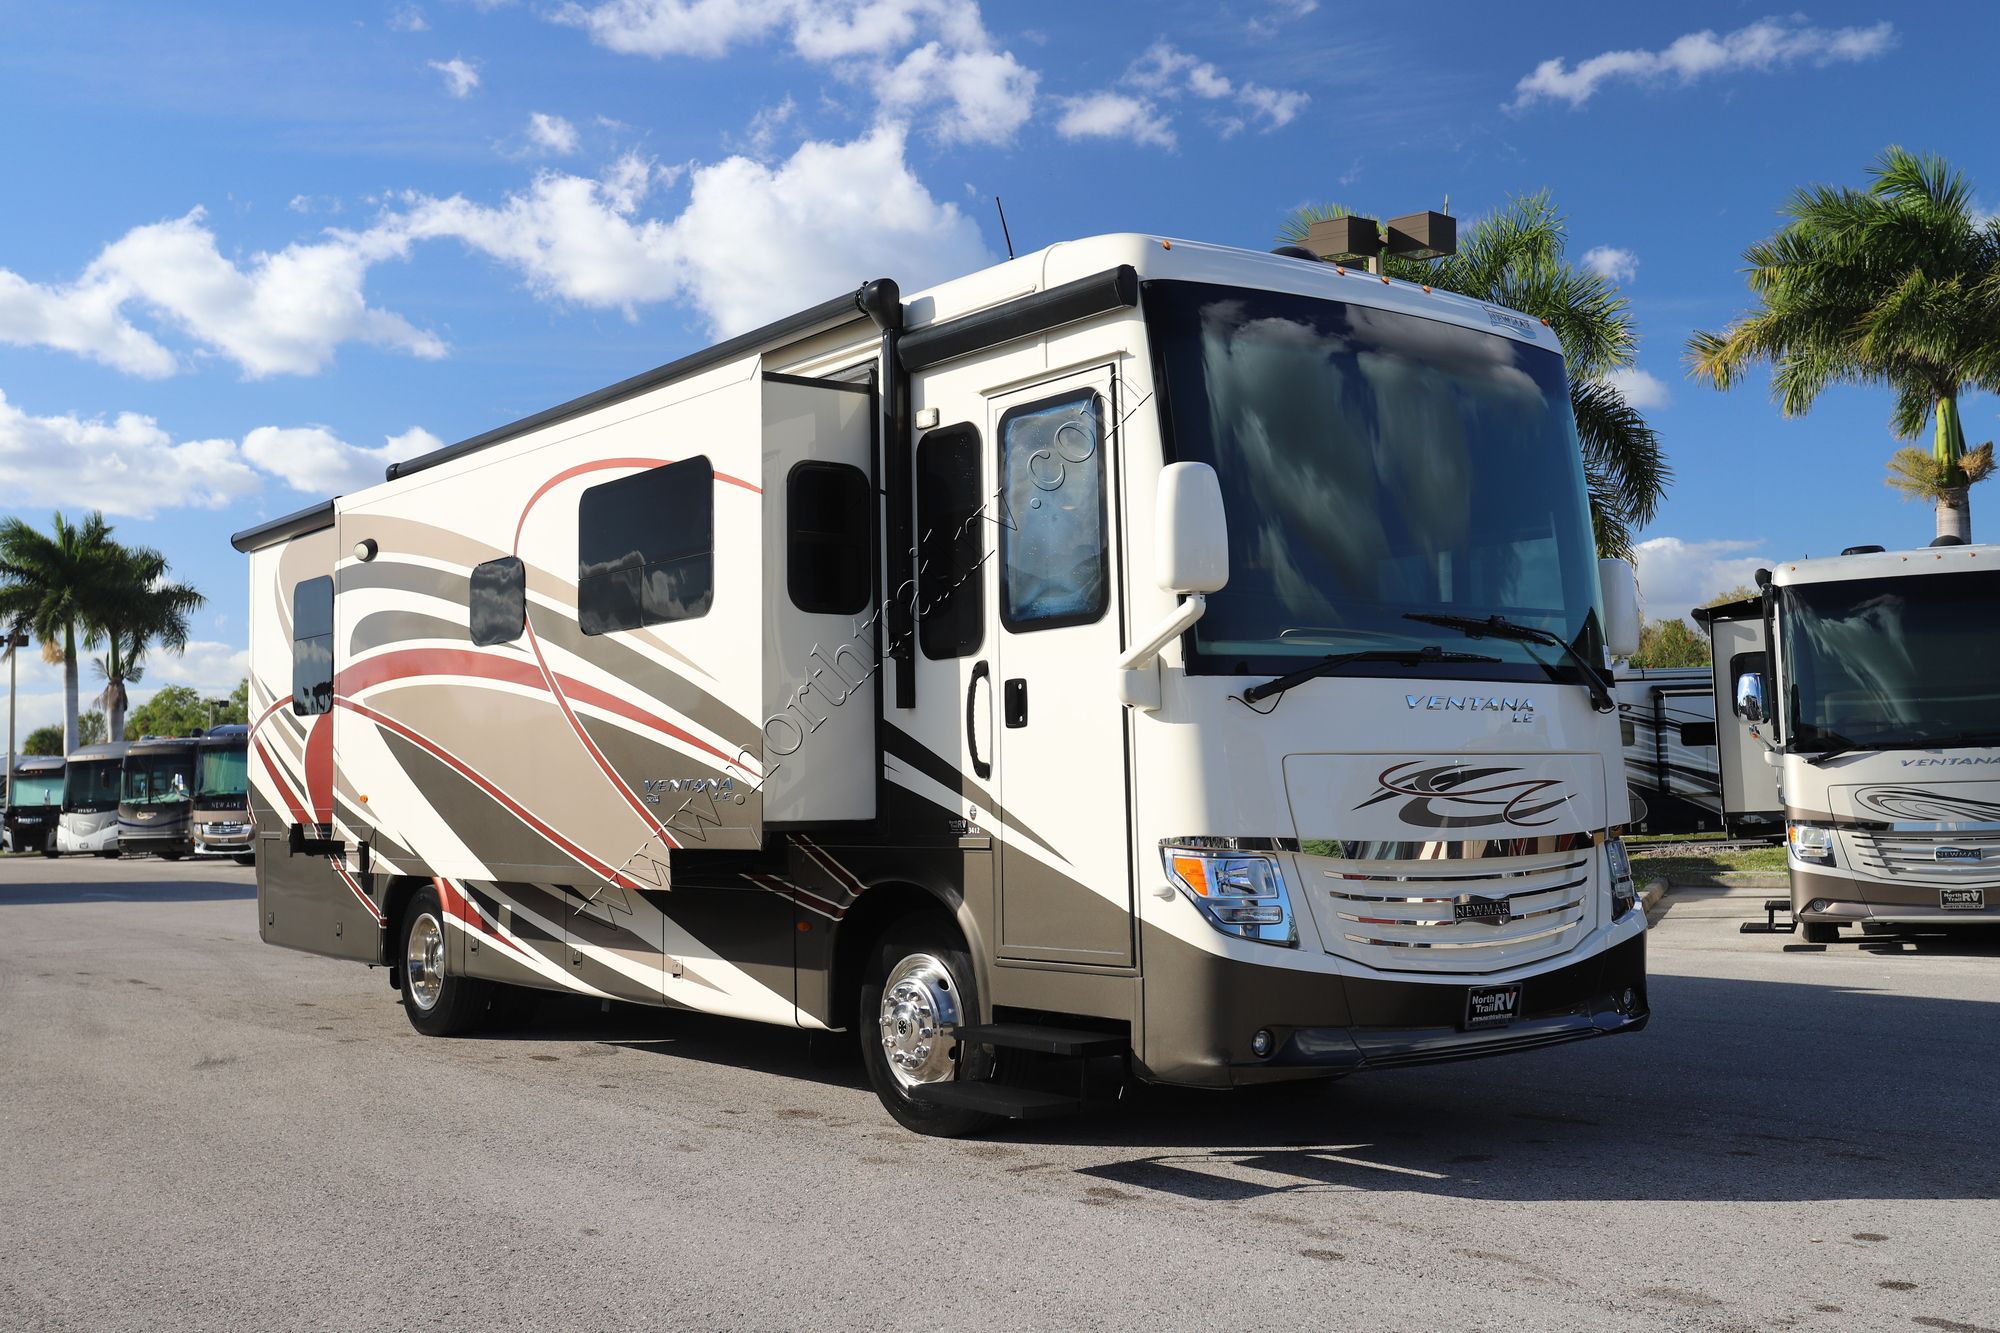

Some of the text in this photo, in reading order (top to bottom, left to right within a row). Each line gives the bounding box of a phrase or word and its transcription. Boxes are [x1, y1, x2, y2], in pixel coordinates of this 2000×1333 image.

[1405, 694, 1534, 712] VENTANA
[1511, 713, 1534, 723] LE
[1901, 757, 2000, 767] VENTANA
[644, 777, 733, 793] VENTANA
[713, 791, 733, 802] LE
[1962, 892, 1980, 902] RV
[1456, 902, 1510, 918] NEWMAR
[1472, 994, 1495, 1005] North
[1494, 991, 1517, 1012] RV
[1475, 1003, 1494, 1014] Trail
